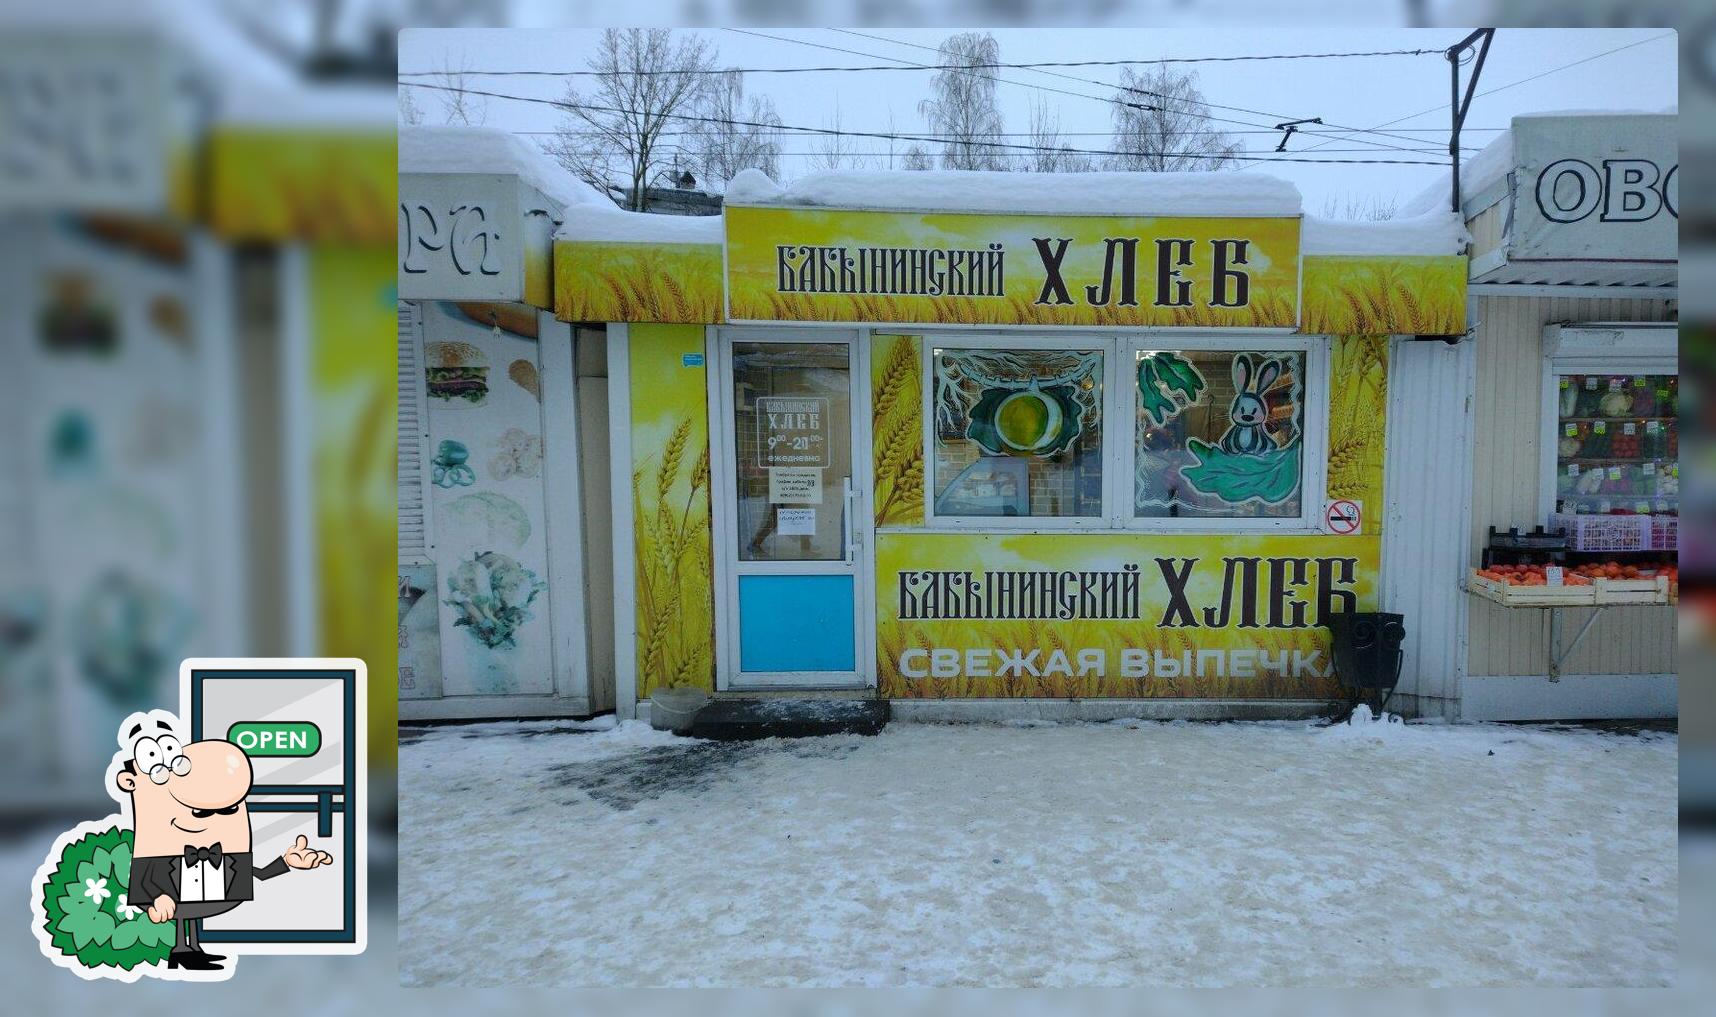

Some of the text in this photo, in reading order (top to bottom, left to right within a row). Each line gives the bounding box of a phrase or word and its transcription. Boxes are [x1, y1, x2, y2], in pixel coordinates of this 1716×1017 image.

[1535, 158, 1678, 224] ОВ
[776, 237, 1250, 306] БАБЫНИНСКИЙ ХЛЕБ
[767, 413, 820, 430] ХЛЕБ
[767, 455, 820, 463] ежедневно
[897, 557, 1358, 629] БАБЫНИНСКИЙ ХЛЕБ
[899, 648, 1106, 679] СВЕЖАЯ
